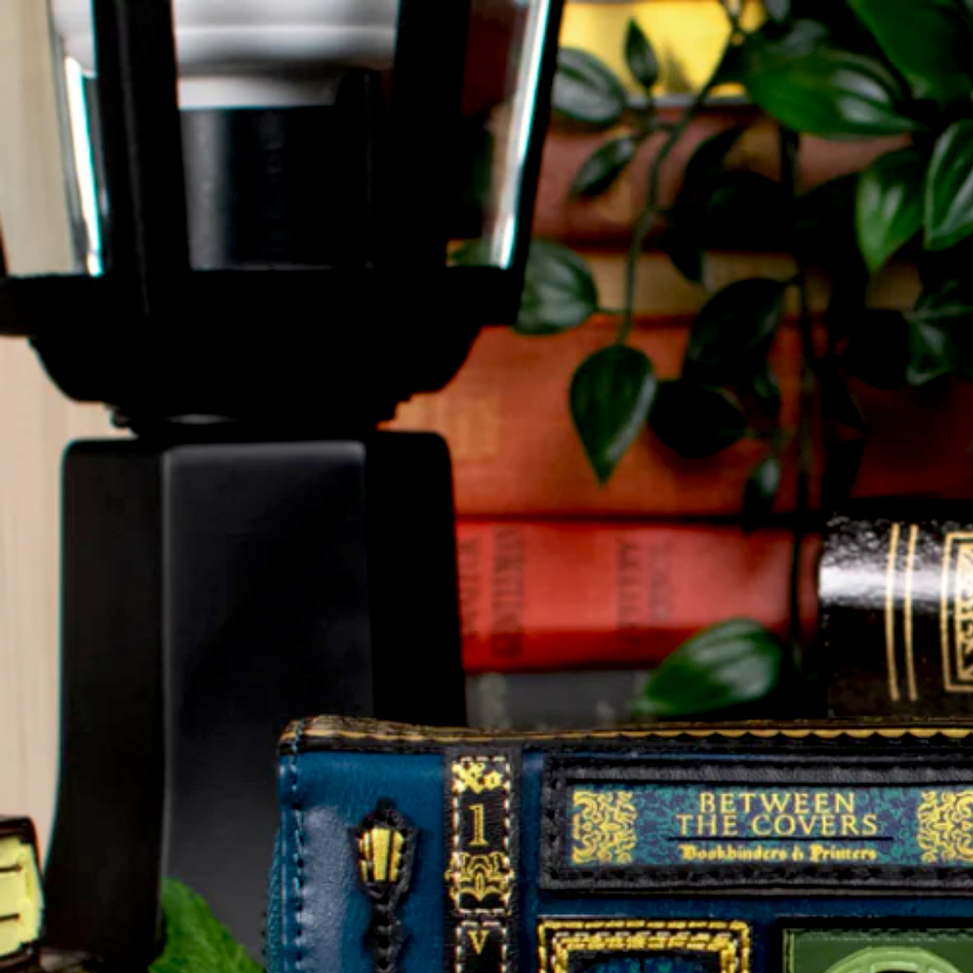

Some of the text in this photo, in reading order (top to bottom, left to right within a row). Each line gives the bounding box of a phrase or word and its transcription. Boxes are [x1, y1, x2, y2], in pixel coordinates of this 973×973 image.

[700, 792, 855, 814] BETWEEN
[467, 803, 491, 846] 1
[676, 814, 877, 837] THE COVERS
[678, 843, 787, 861] Bookbinders
[809, 843, 877, 863] Printers
